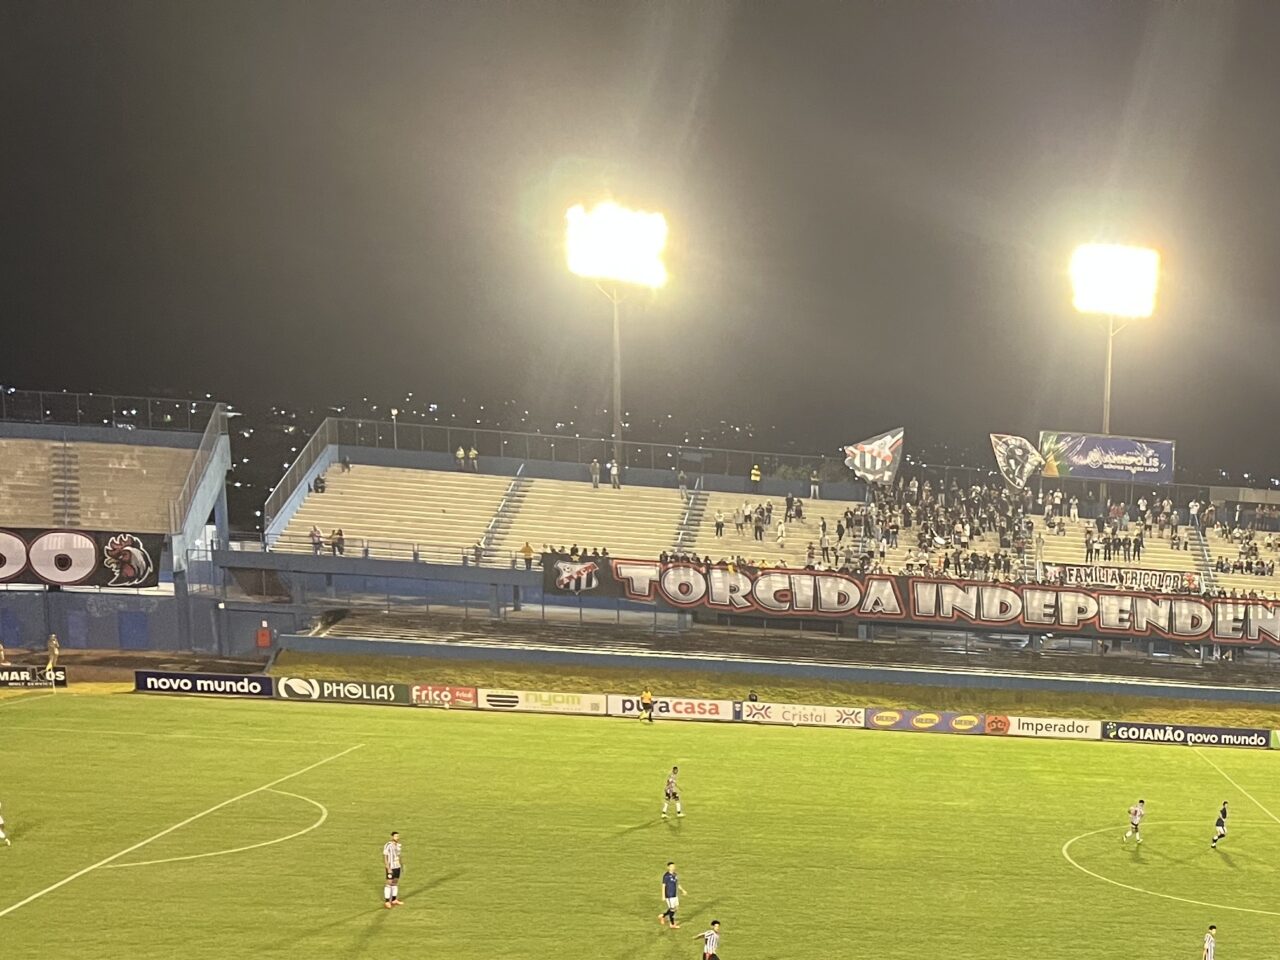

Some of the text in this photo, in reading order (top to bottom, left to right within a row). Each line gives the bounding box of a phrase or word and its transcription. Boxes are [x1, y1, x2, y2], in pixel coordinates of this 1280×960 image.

[612, 559, 904, 619] TORCIDA
[1121, 573, 1181, 589] TRICOLOR
[147, 677, 261, 694] novo mundo
[323, 682, 395, 701] PHOLIAS
[782, 710, 826, 723] Cristal
[1017, 718, 1089, 735] Imperador
[1118, 726, 1266, 746] GOIANÃO novo mundo
